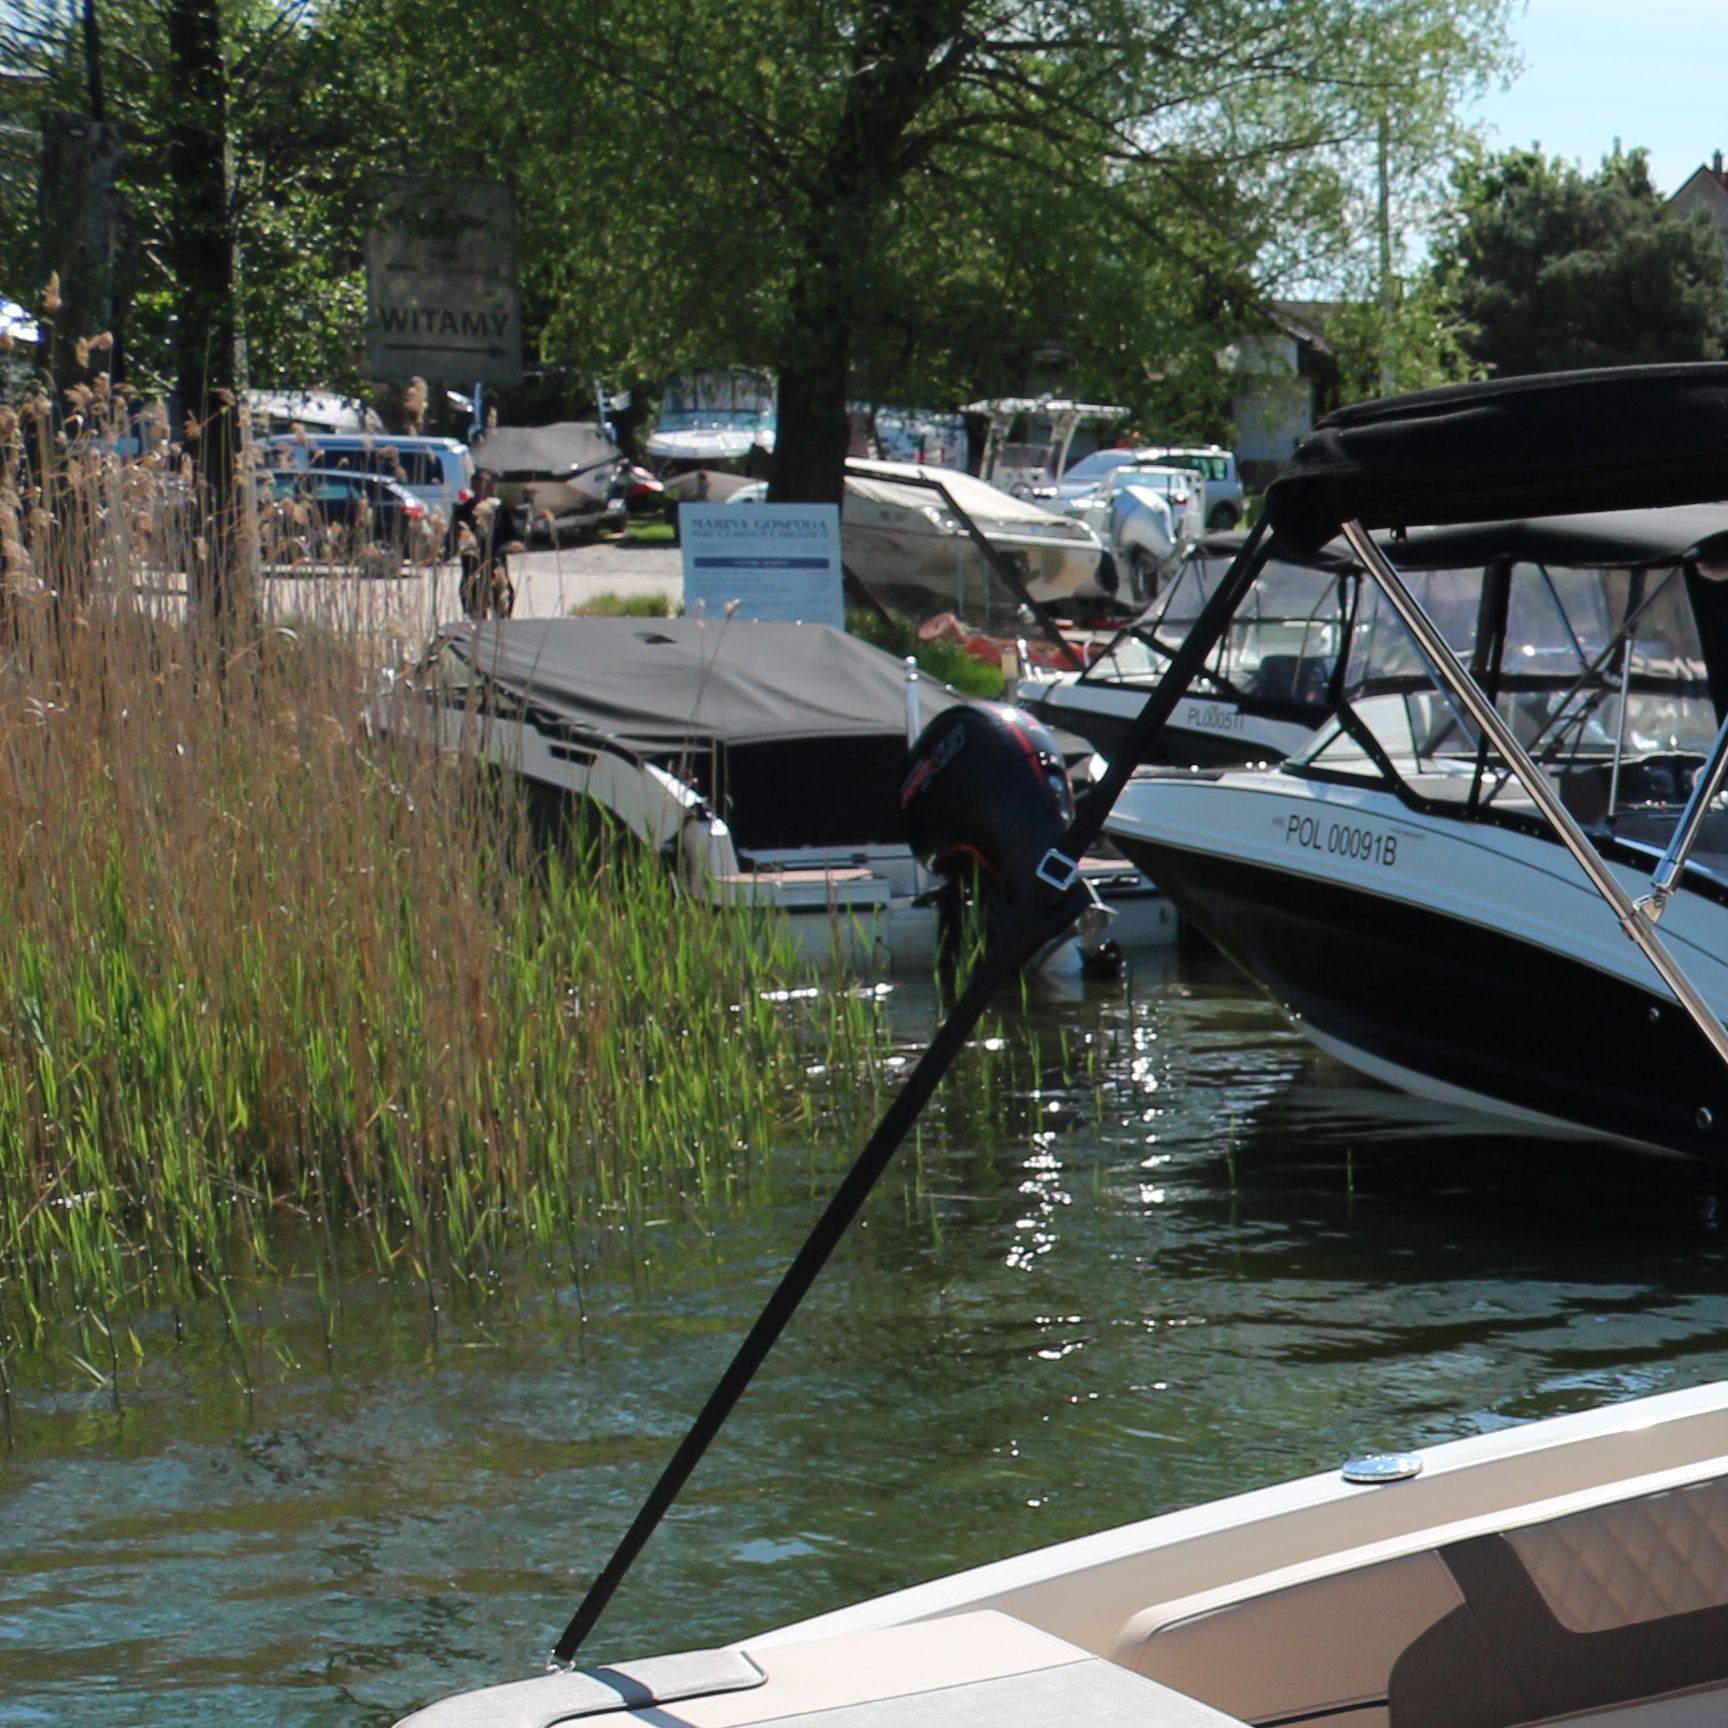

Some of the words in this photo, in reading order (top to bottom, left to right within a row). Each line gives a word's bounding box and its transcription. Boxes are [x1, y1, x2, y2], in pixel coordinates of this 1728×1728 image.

[379, 307, 509, 337] WITAMY
[1286, 814, 1322, 850] POL
[1328, 824, 1398, 866] 00091B
